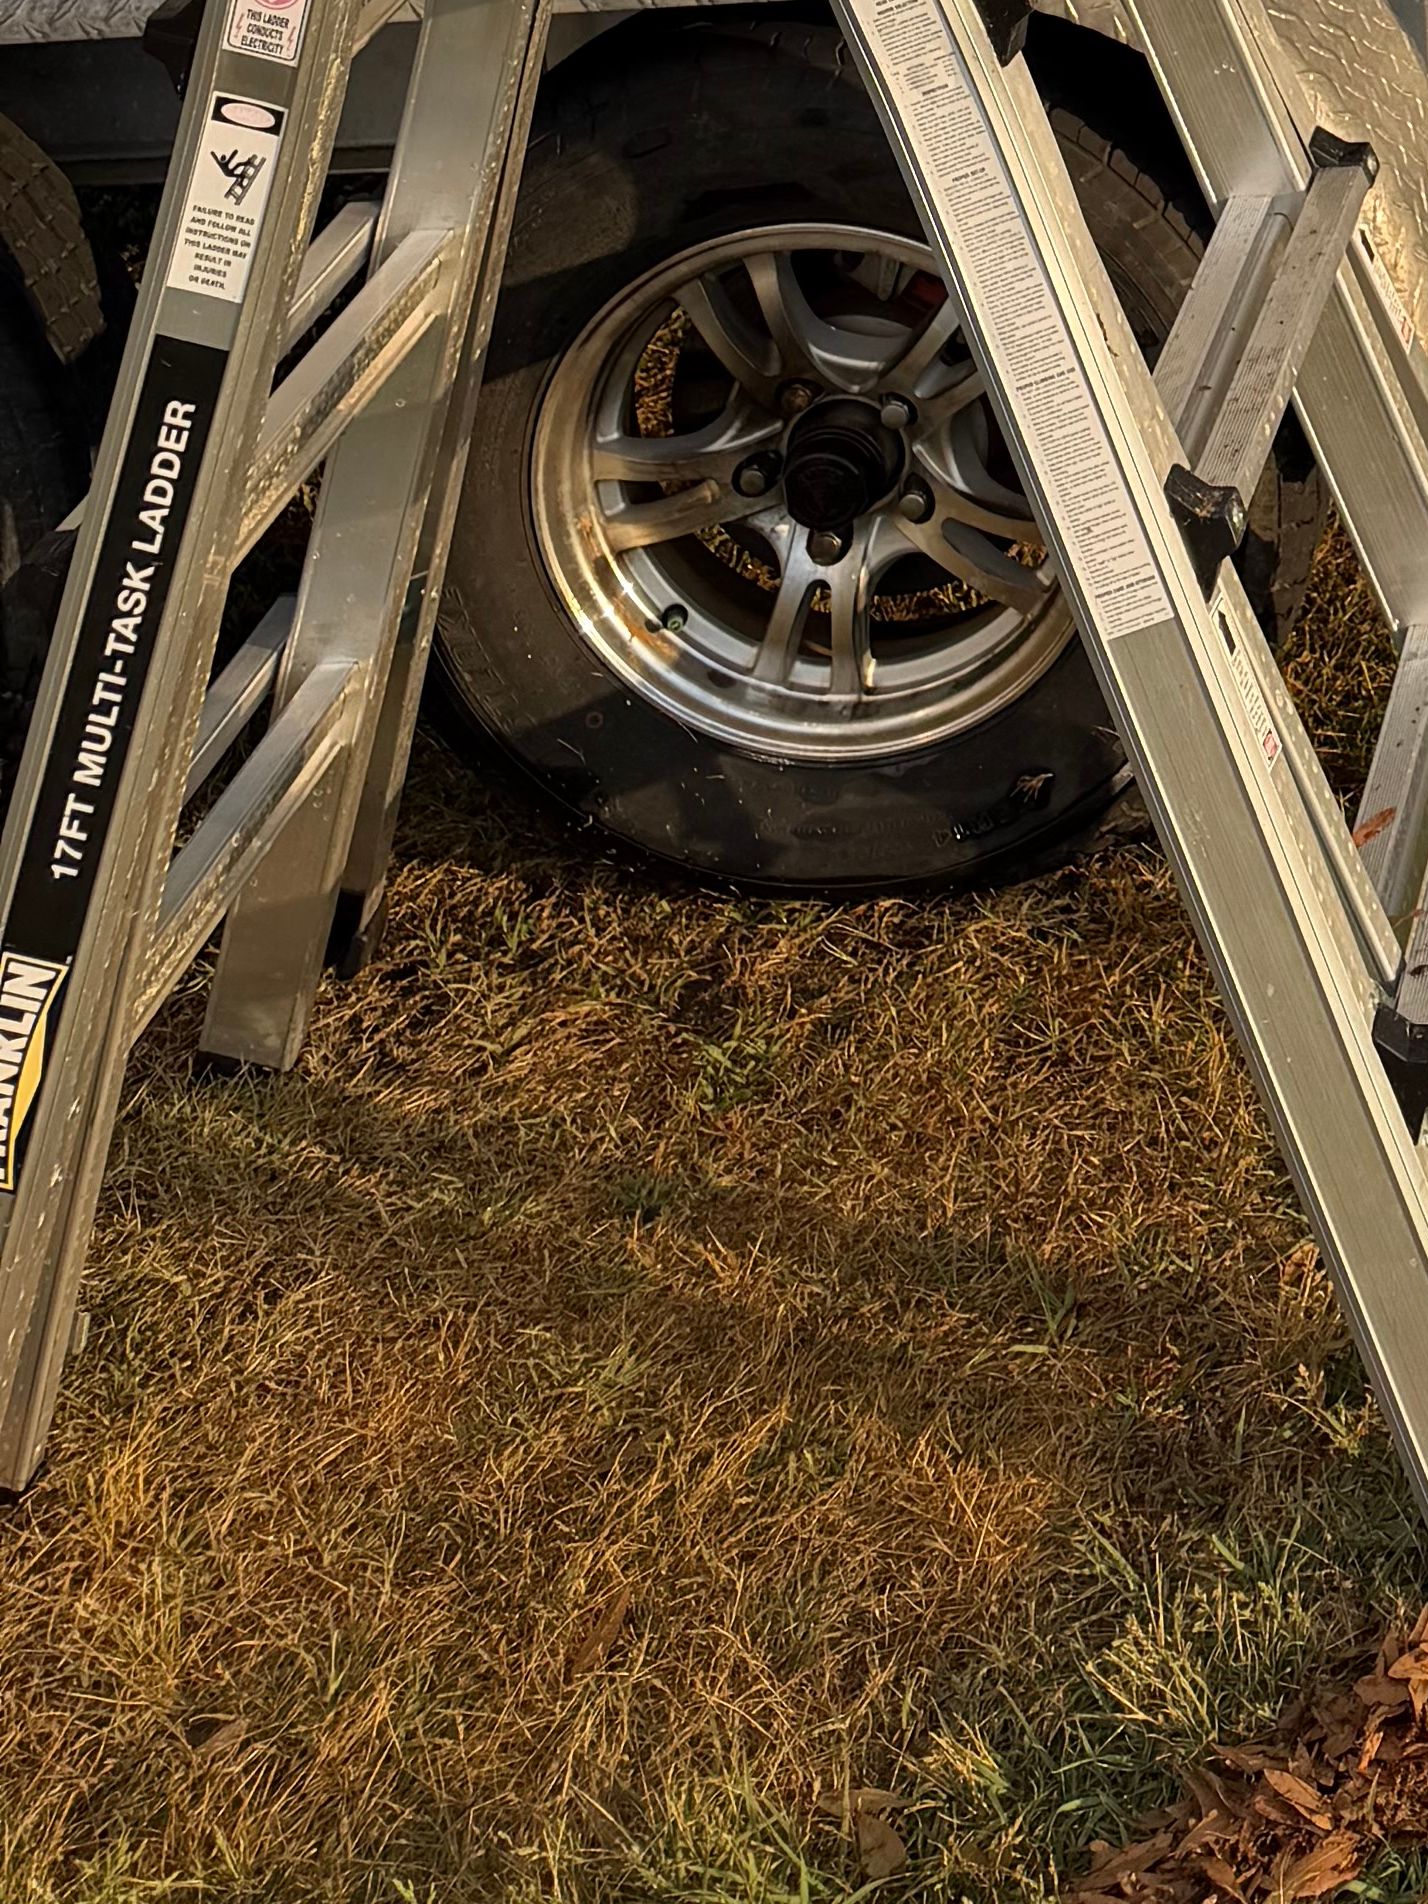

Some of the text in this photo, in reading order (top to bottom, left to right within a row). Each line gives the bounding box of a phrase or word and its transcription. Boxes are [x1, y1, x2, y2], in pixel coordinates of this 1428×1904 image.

[246, 9, 289, 28] THIS LADDER
[246, 23, 283, 40] CONDUCTS
[240, 36, 283, 54] ELECTRICITY
[192, 204, 255, 225] FAILURE TO READ
[184, 226, 238, 245] INSTRUCTIONS
[190, 216, 251, 236] AND FOLLOW ALL
[202, 242, 230, 255] LADDER
[193, 252, 222, 265] RESULT
[51, 399, 196, 879] 17FT MULTI-TASK LADDER
